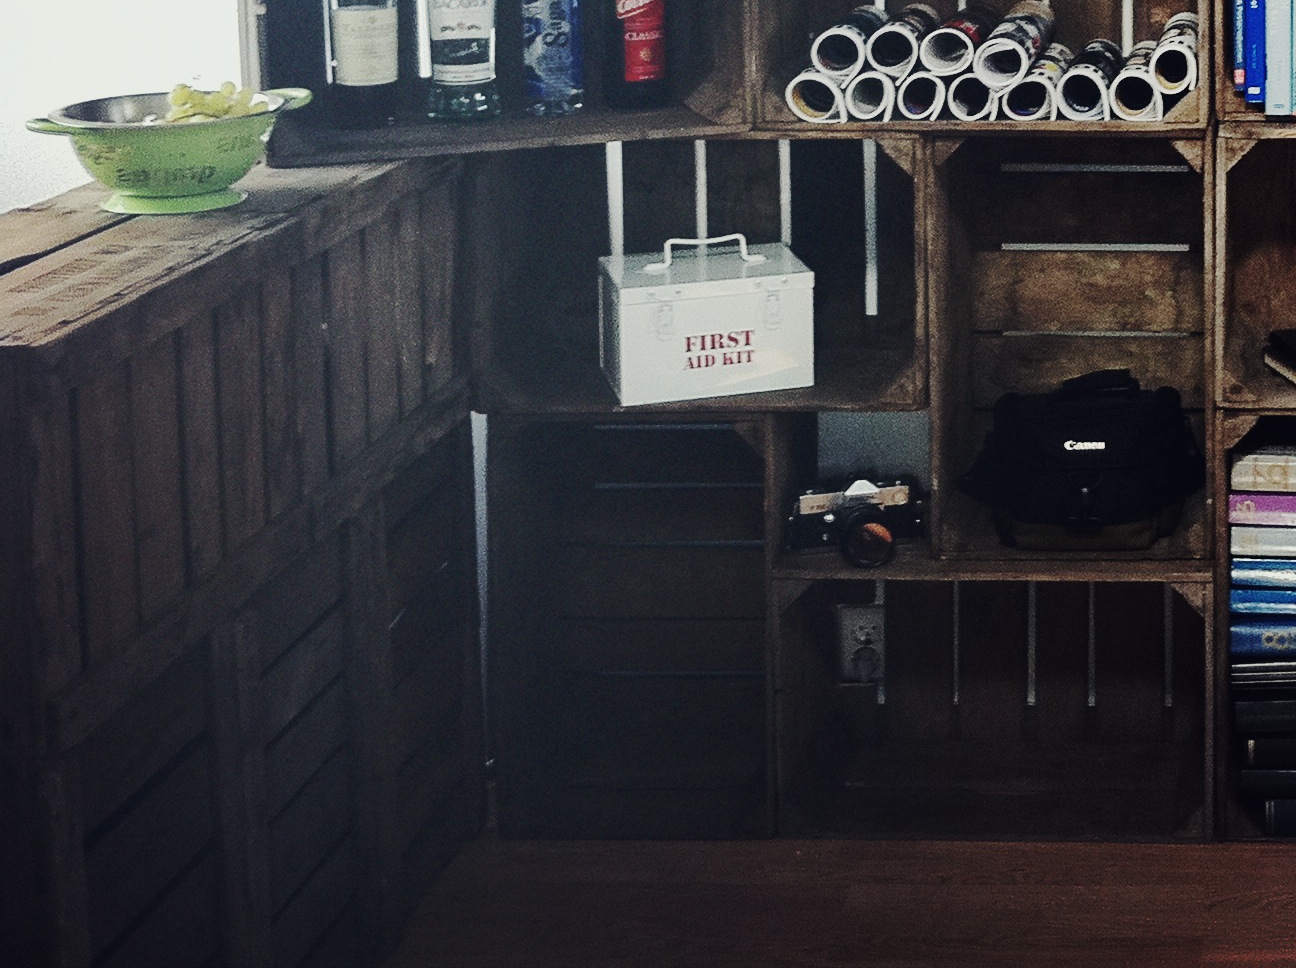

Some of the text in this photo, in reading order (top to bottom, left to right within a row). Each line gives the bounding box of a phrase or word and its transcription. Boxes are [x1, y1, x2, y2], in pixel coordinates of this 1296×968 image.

[685, 330, 754, 352] FIRST
[684, 349, 755, 370] AID KIT
[1063, 440, 1106, 450] Canon
